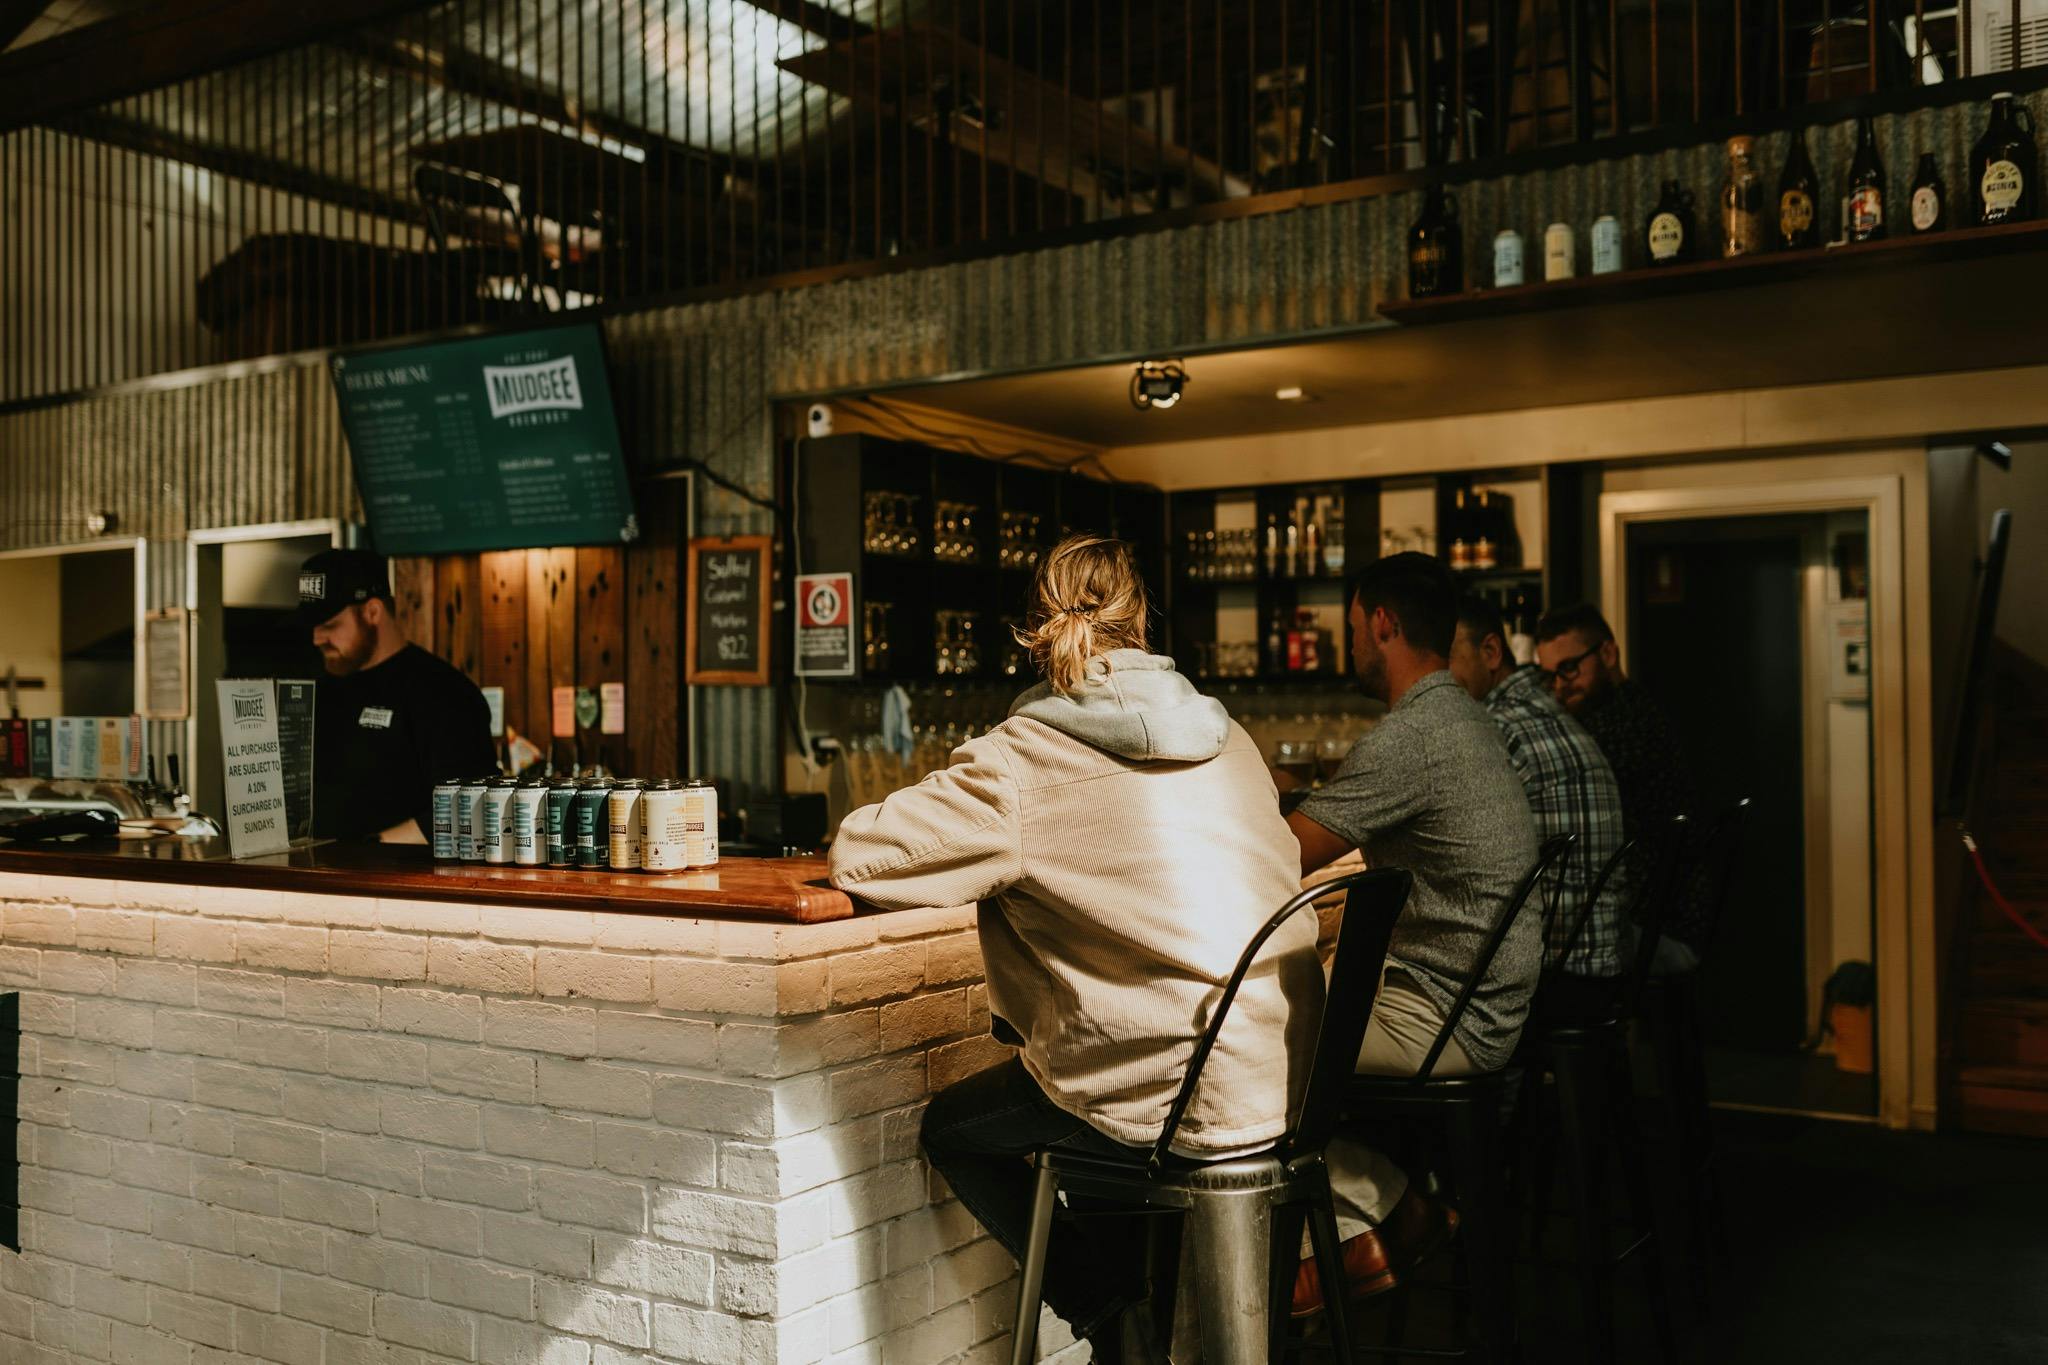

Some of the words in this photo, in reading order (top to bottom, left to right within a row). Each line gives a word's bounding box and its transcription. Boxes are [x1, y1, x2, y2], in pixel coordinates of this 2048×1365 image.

[493, 366, 574, 408] MUDGEE
[234, 698, 264, 718] MUDGEE
[228, 746, 240, 757] ALL
[241, 742, 278, 755] PURCHASES
[229, 764, 242, 776] ARE
[243, 761, 271, 775] SUBJECT
[272, 760, 281, 771] TO
[247, 782, 253, 794] A
[253, 781, 267, 793] 10%
[232, 799, 272, 816] SURCHARGE
[273, 798, 282, 809] ON
[244, 818, 275, 834] SUNDAYS
[548, 806, 561, 832] IPA
[577, 807, 592, 833] IPA
